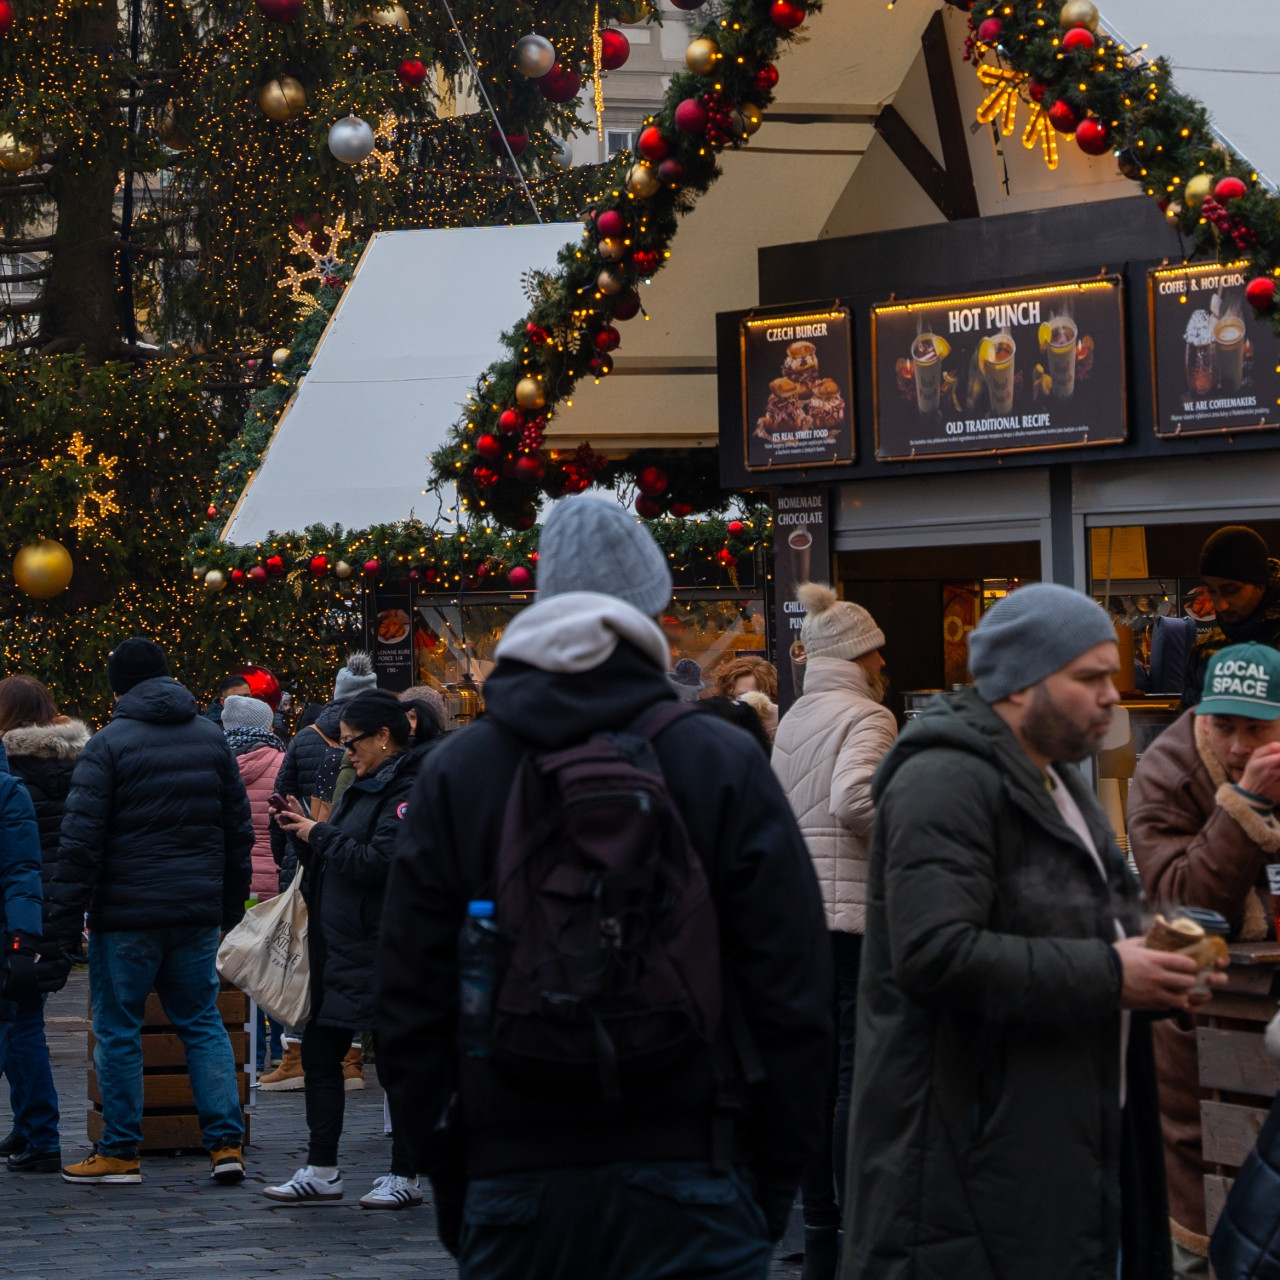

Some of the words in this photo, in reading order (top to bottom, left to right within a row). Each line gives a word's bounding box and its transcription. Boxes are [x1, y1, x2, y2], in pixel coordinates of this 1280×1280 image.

[1191, 279, 1200, 291] &
[1201, 276, 1219, 290] HOT
[949, 308, 981, 333] HOT
[984, 301, 1041, 329] PUNCH
[766, 327, 794, 342] CZECH
[795, 323, 828, 339] BURGER
[1184, 401, 1194, 412] WE
[1195, 400, 1208, 411] ARE
[1209, 396, 1257, 409] COFFEEMAKERS
[946, 422, 964, 435] OLD
[965, 416, 1021, 433] TRADITIONAL
[1022, 413, 1051, 428] RECIPE
[772, 432, 781, 441] ITS
[781, 431, 795, 441] REAL
[795, 430, 812, 440] STREET
[813, 428, 829, 439] FOOD
[778, 496, 822, 510] HOMEMADE
[778, 512, 823, 525] CHOCOLATE
[783, 601, 807, 613] CHILD
[789, 618, 804, 630] PUN
[1213, 660, 1270, 681] LOCAL
[1211, 677, 1268, 698] SPACE
